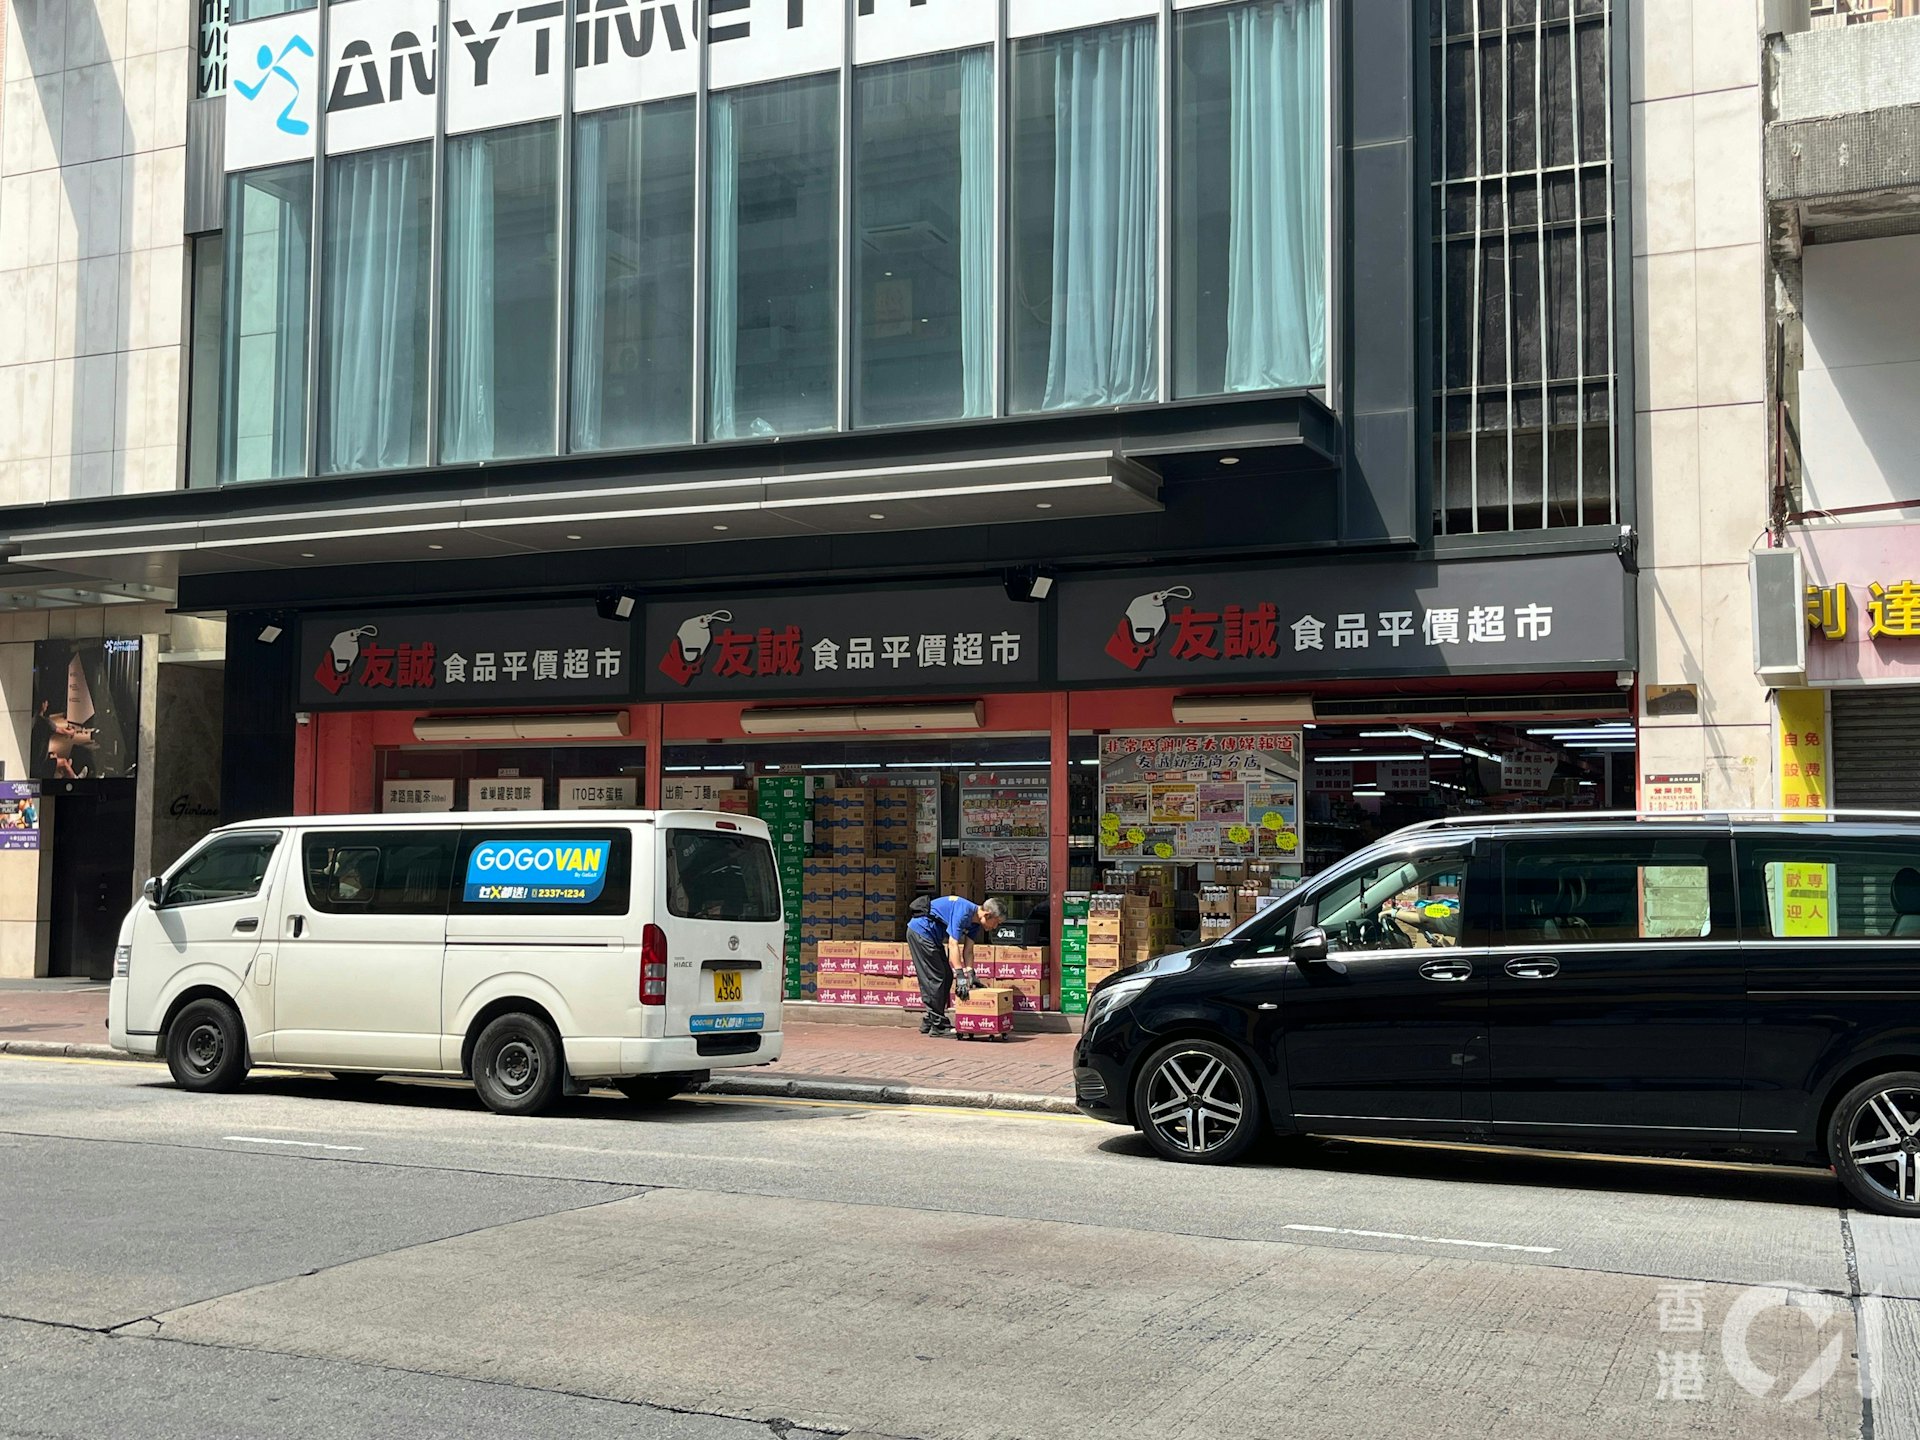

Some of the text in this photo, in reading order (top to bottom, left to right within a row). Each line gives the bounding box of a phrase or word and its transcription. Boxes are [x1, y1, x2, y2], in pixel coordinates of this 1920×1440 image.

[1170, 603, 1553, 659] 友誠 食品平價超市
[711, 625, 1021, 678] 友誠 食品平價超市
[359, 642, 622, 688] 友誠 食品平價超市
[476, 848, 601, 871] GOGOVAN
[538, 889, 586, 898] 2337-1234
[1786, 873, 1802, 919] 歡迎
[722, 974, 734, 986] NN
[717, 987, 741, 1000] 4360
[959, 1017, 995, 1026] vita vita
